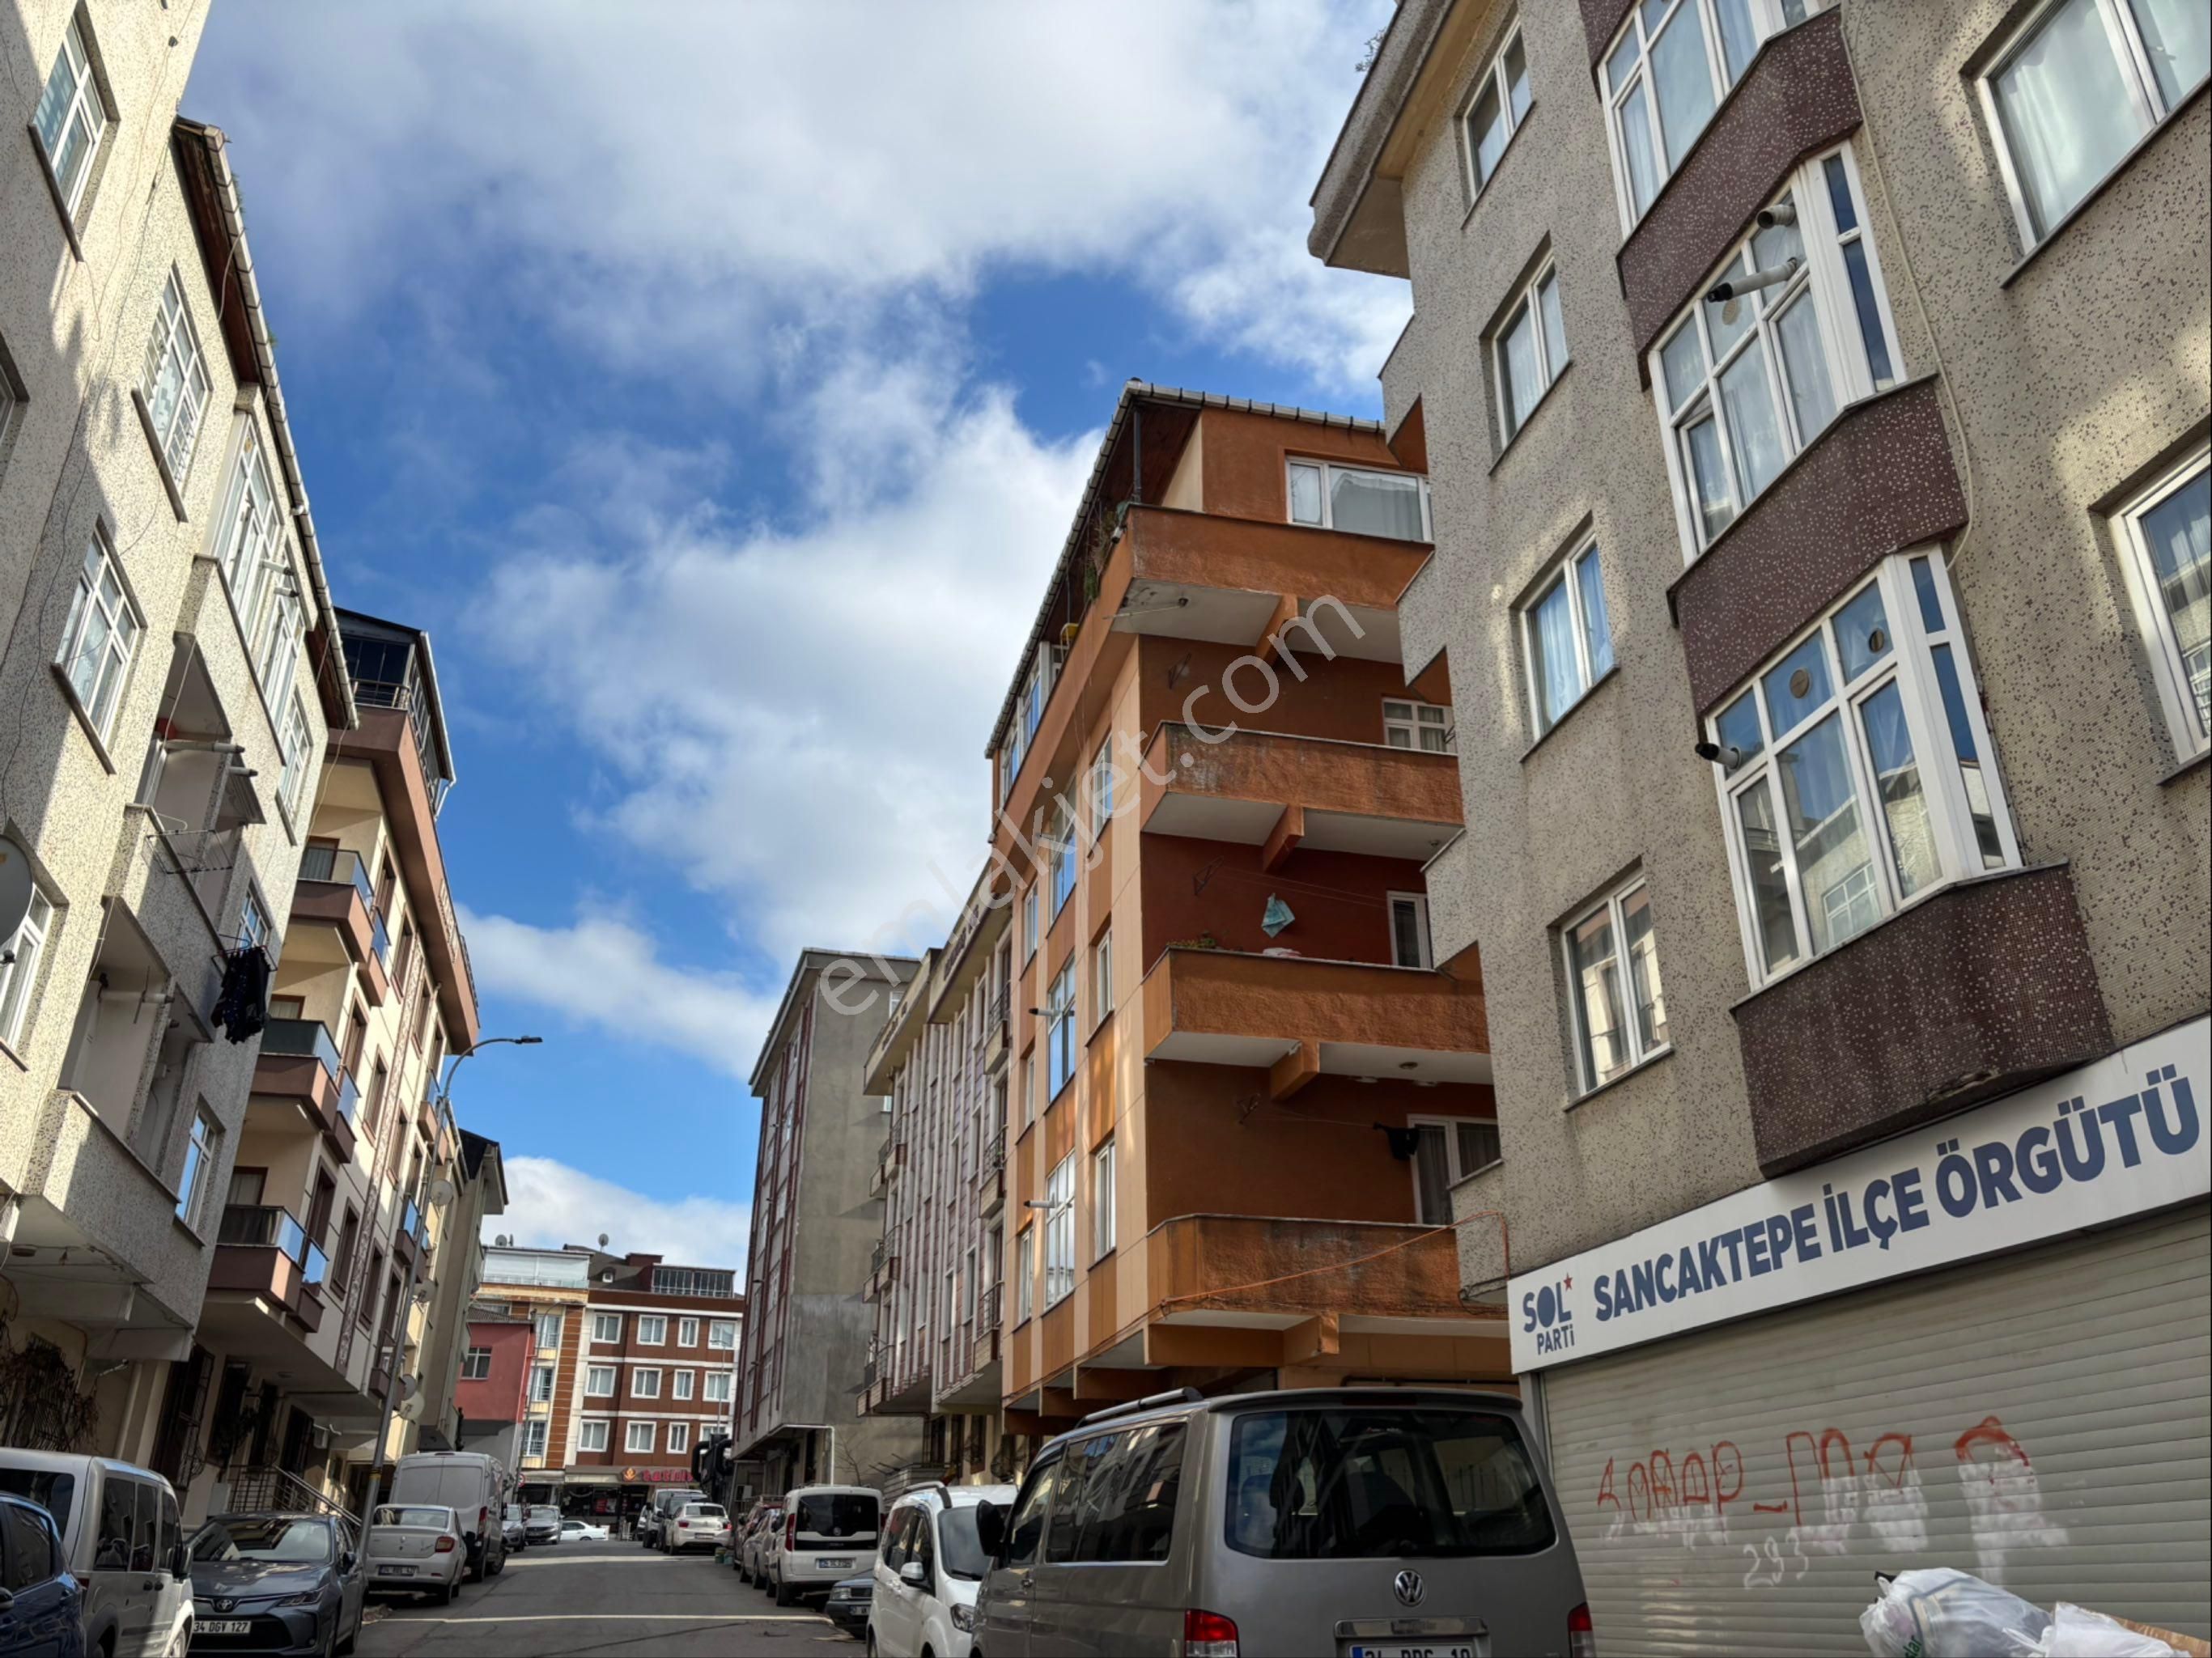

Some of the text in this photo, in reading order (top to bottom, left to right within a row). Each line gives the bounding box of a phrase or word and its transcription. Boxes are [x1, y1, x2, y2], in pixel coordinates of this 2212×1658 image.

[1594, 1063, 2201, 1322] SANCAKTEPE İLÇE ÖRGÜTÜ
[1522, 1281, 1573, 1334] SOL
[231, 1622, 248, 1632] 127
